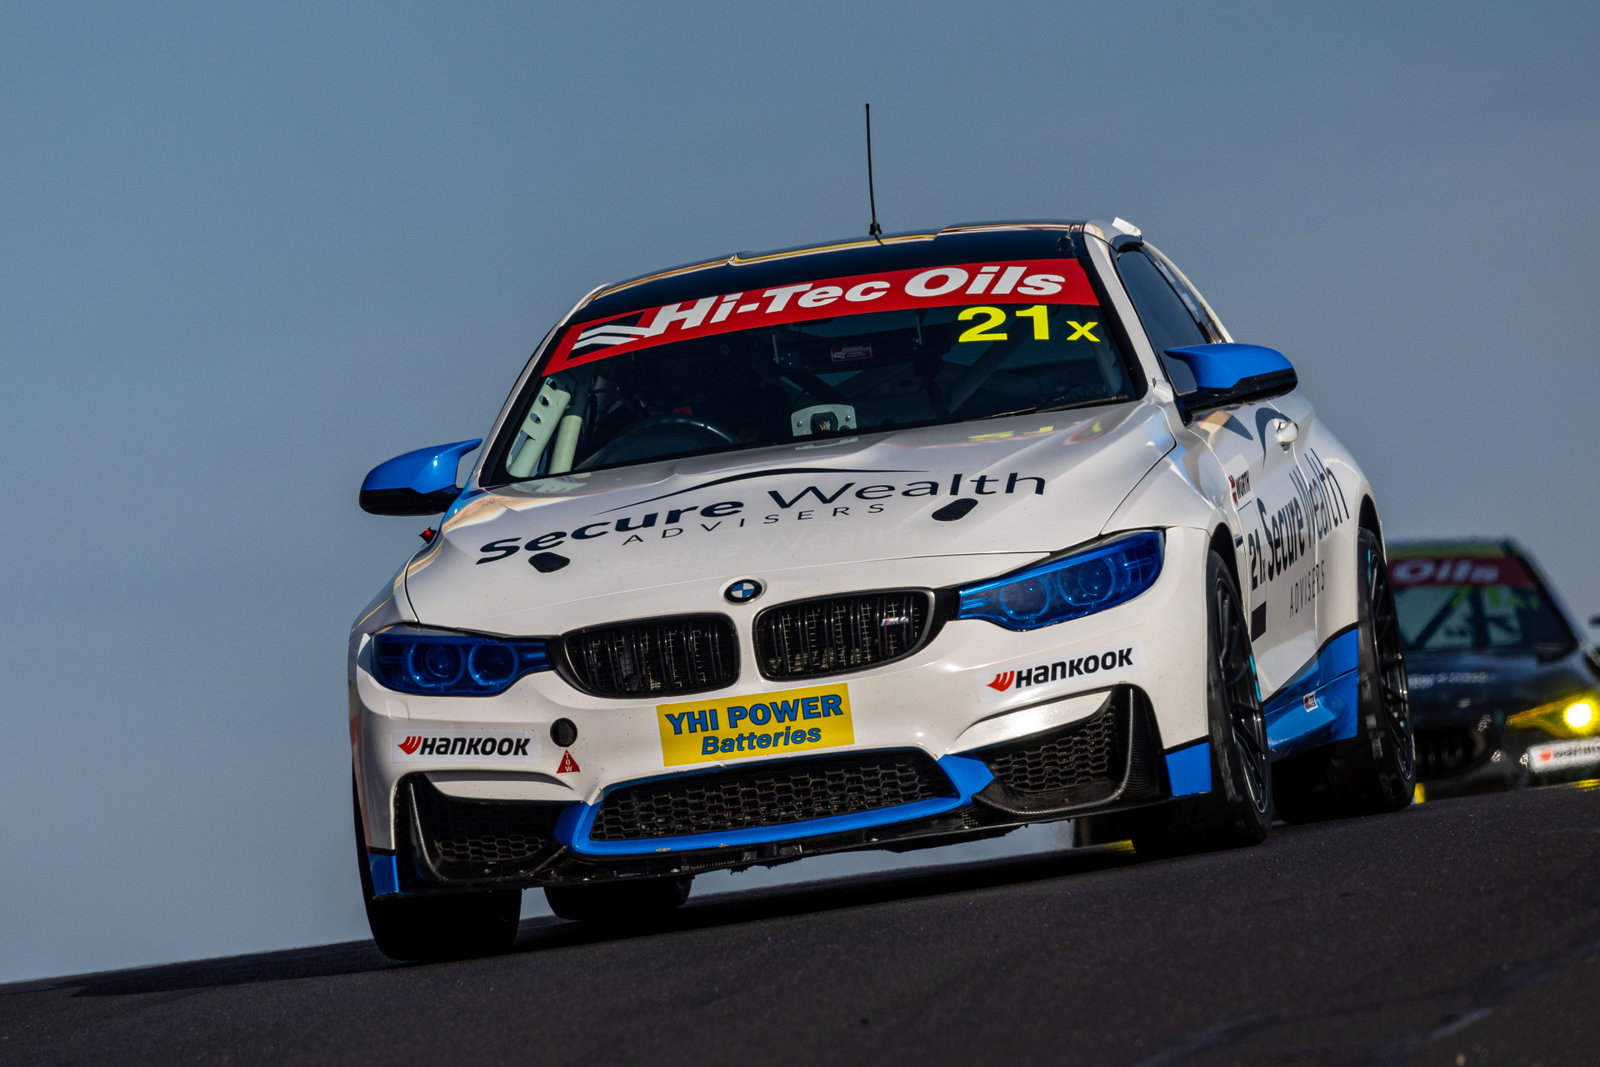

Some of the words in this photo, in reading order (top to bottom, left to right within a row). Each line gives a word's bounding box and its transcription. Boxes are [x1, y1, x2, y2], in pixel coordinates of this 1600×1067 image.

[643, 281, 890, 338] Hi-Tec
[904, 265, 1066, 298] Oils
[766, 472, 1048, 510] Wealth
[622, 502, 884, 546] ADVISERS
[1015, 647, 1134, 689] HANKOOK
[665, 709, 719, 736] YHI
[727, 693, 844, 729] POWER
[419, 737, 531, 756] HANKOOK
[701, 726, 823, 756] Batteries
